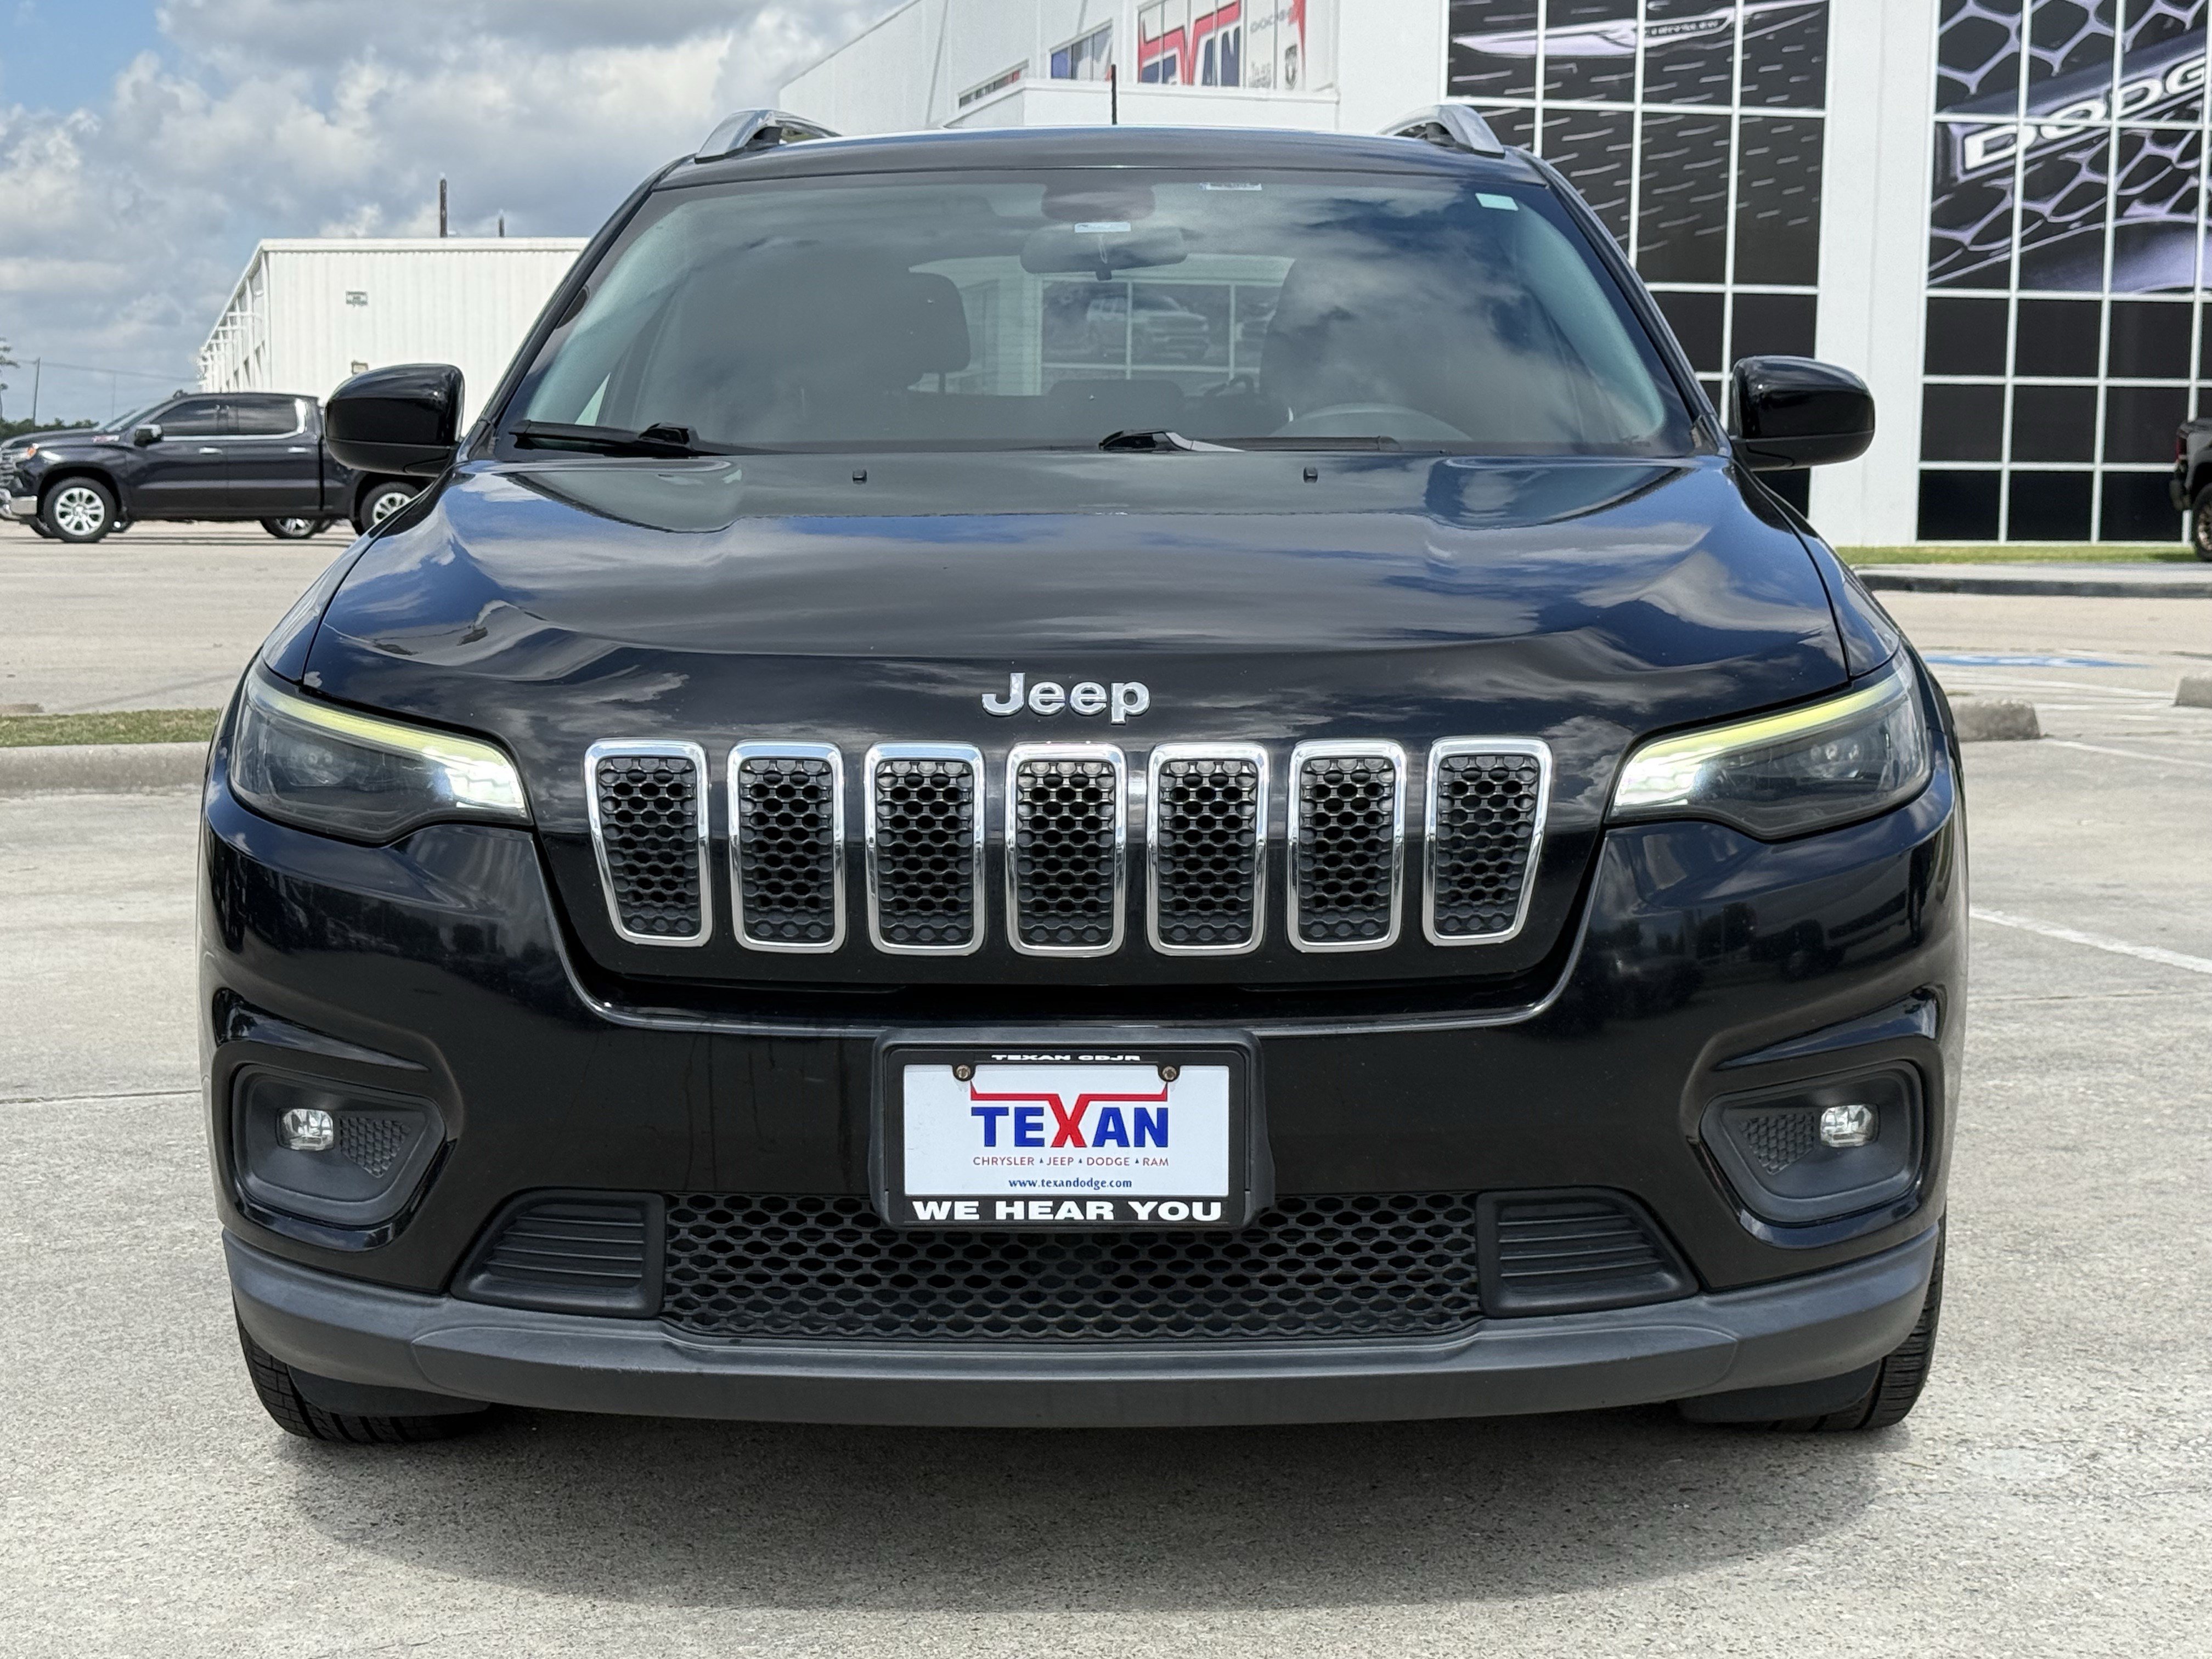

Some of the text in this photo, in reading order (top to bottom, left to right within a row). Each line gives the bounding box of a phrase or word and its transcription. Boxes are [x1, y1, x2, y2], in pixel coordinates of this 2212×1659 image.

[981, 673, 1151, 724] Jeep
[970, 1093, 1169, 1148] TEXAN
[973, 1156, 1169, 1166] CHRYSLER JEEP DODGE RAM
[1008, 1177, 1132, 1190] www.texandodge.com
[912, 1201, 1222, 1221] WE HEAR YOU
